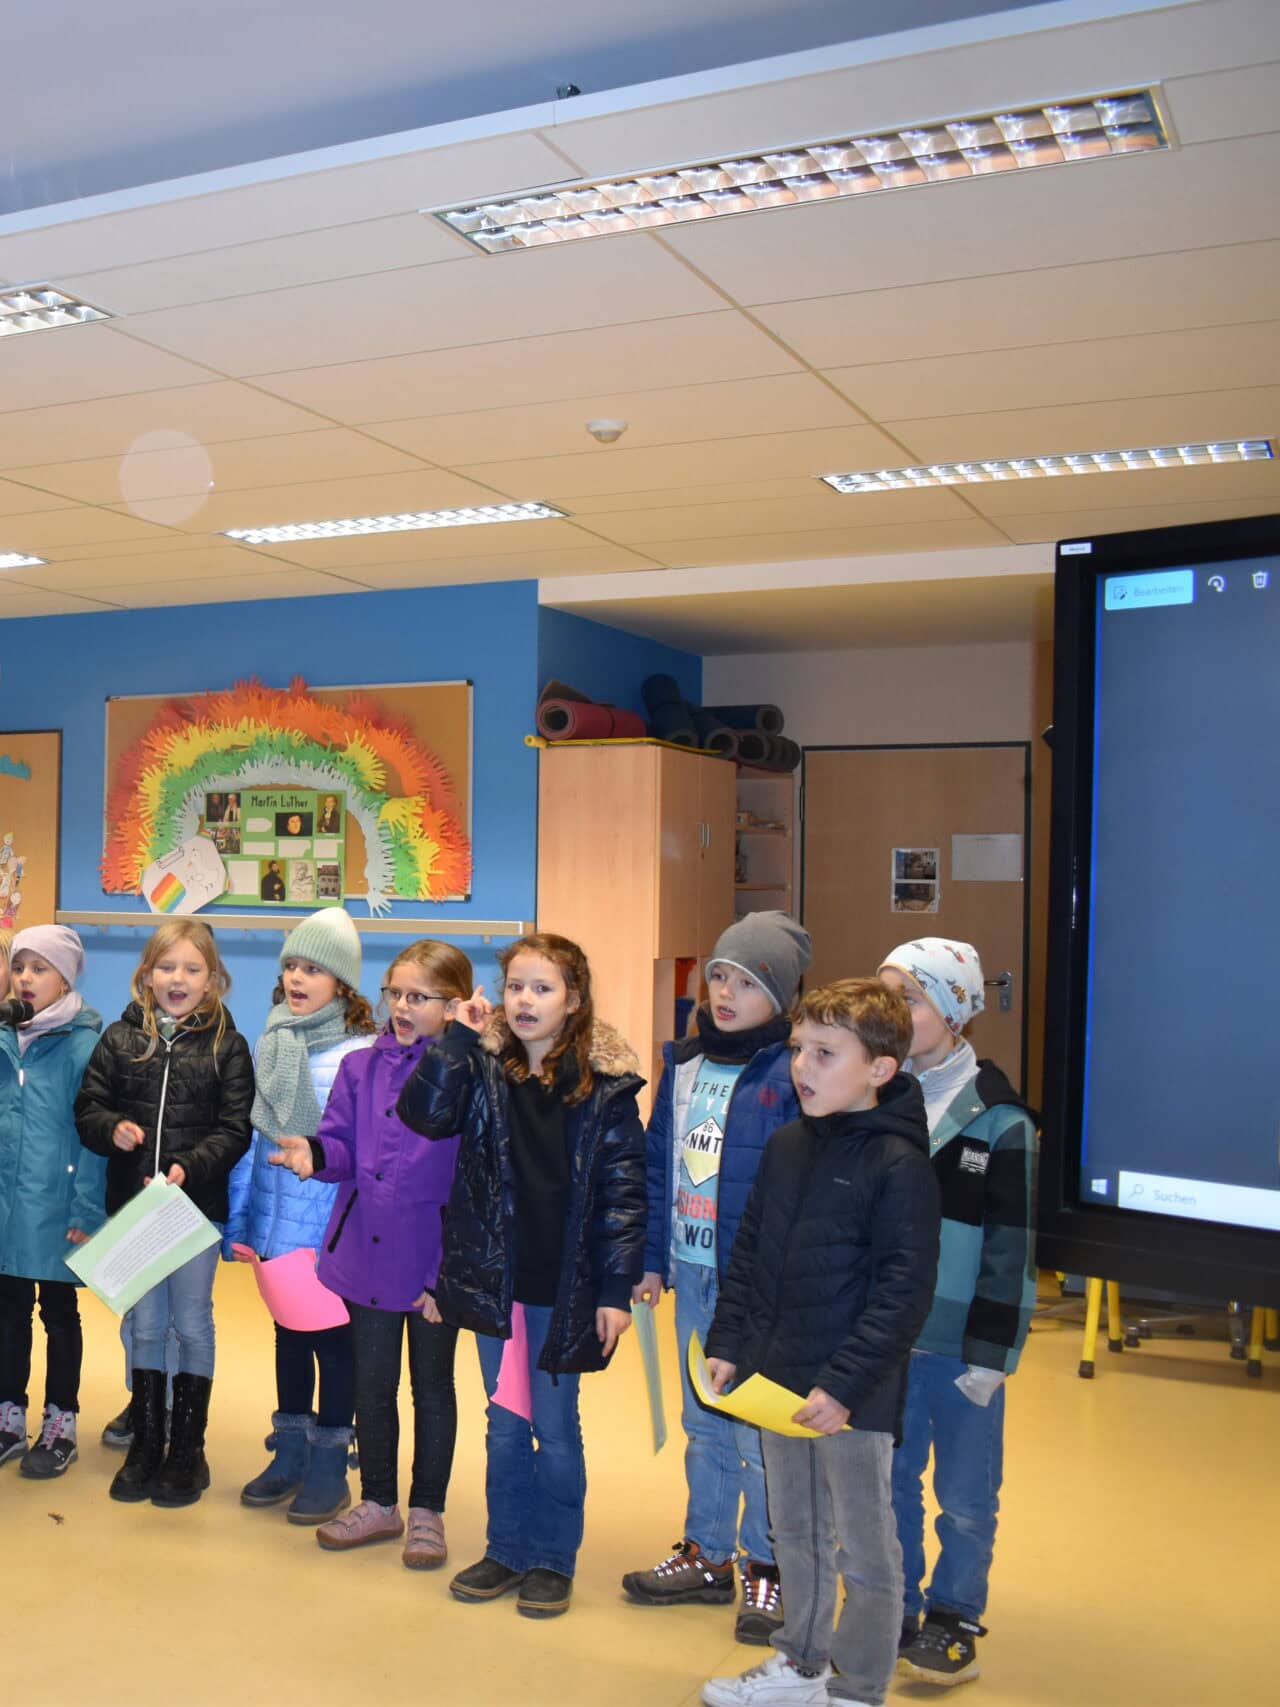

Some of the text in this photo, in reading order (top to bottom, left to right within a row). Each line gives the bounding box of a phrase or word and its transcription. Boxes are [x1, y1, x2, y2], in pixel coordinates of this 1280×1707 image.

[251, 795, 308, 808] Martin Luther
[686, 1132, 723, 1154] NMT
[1152, 1190, 1196, 1205] Suchen
